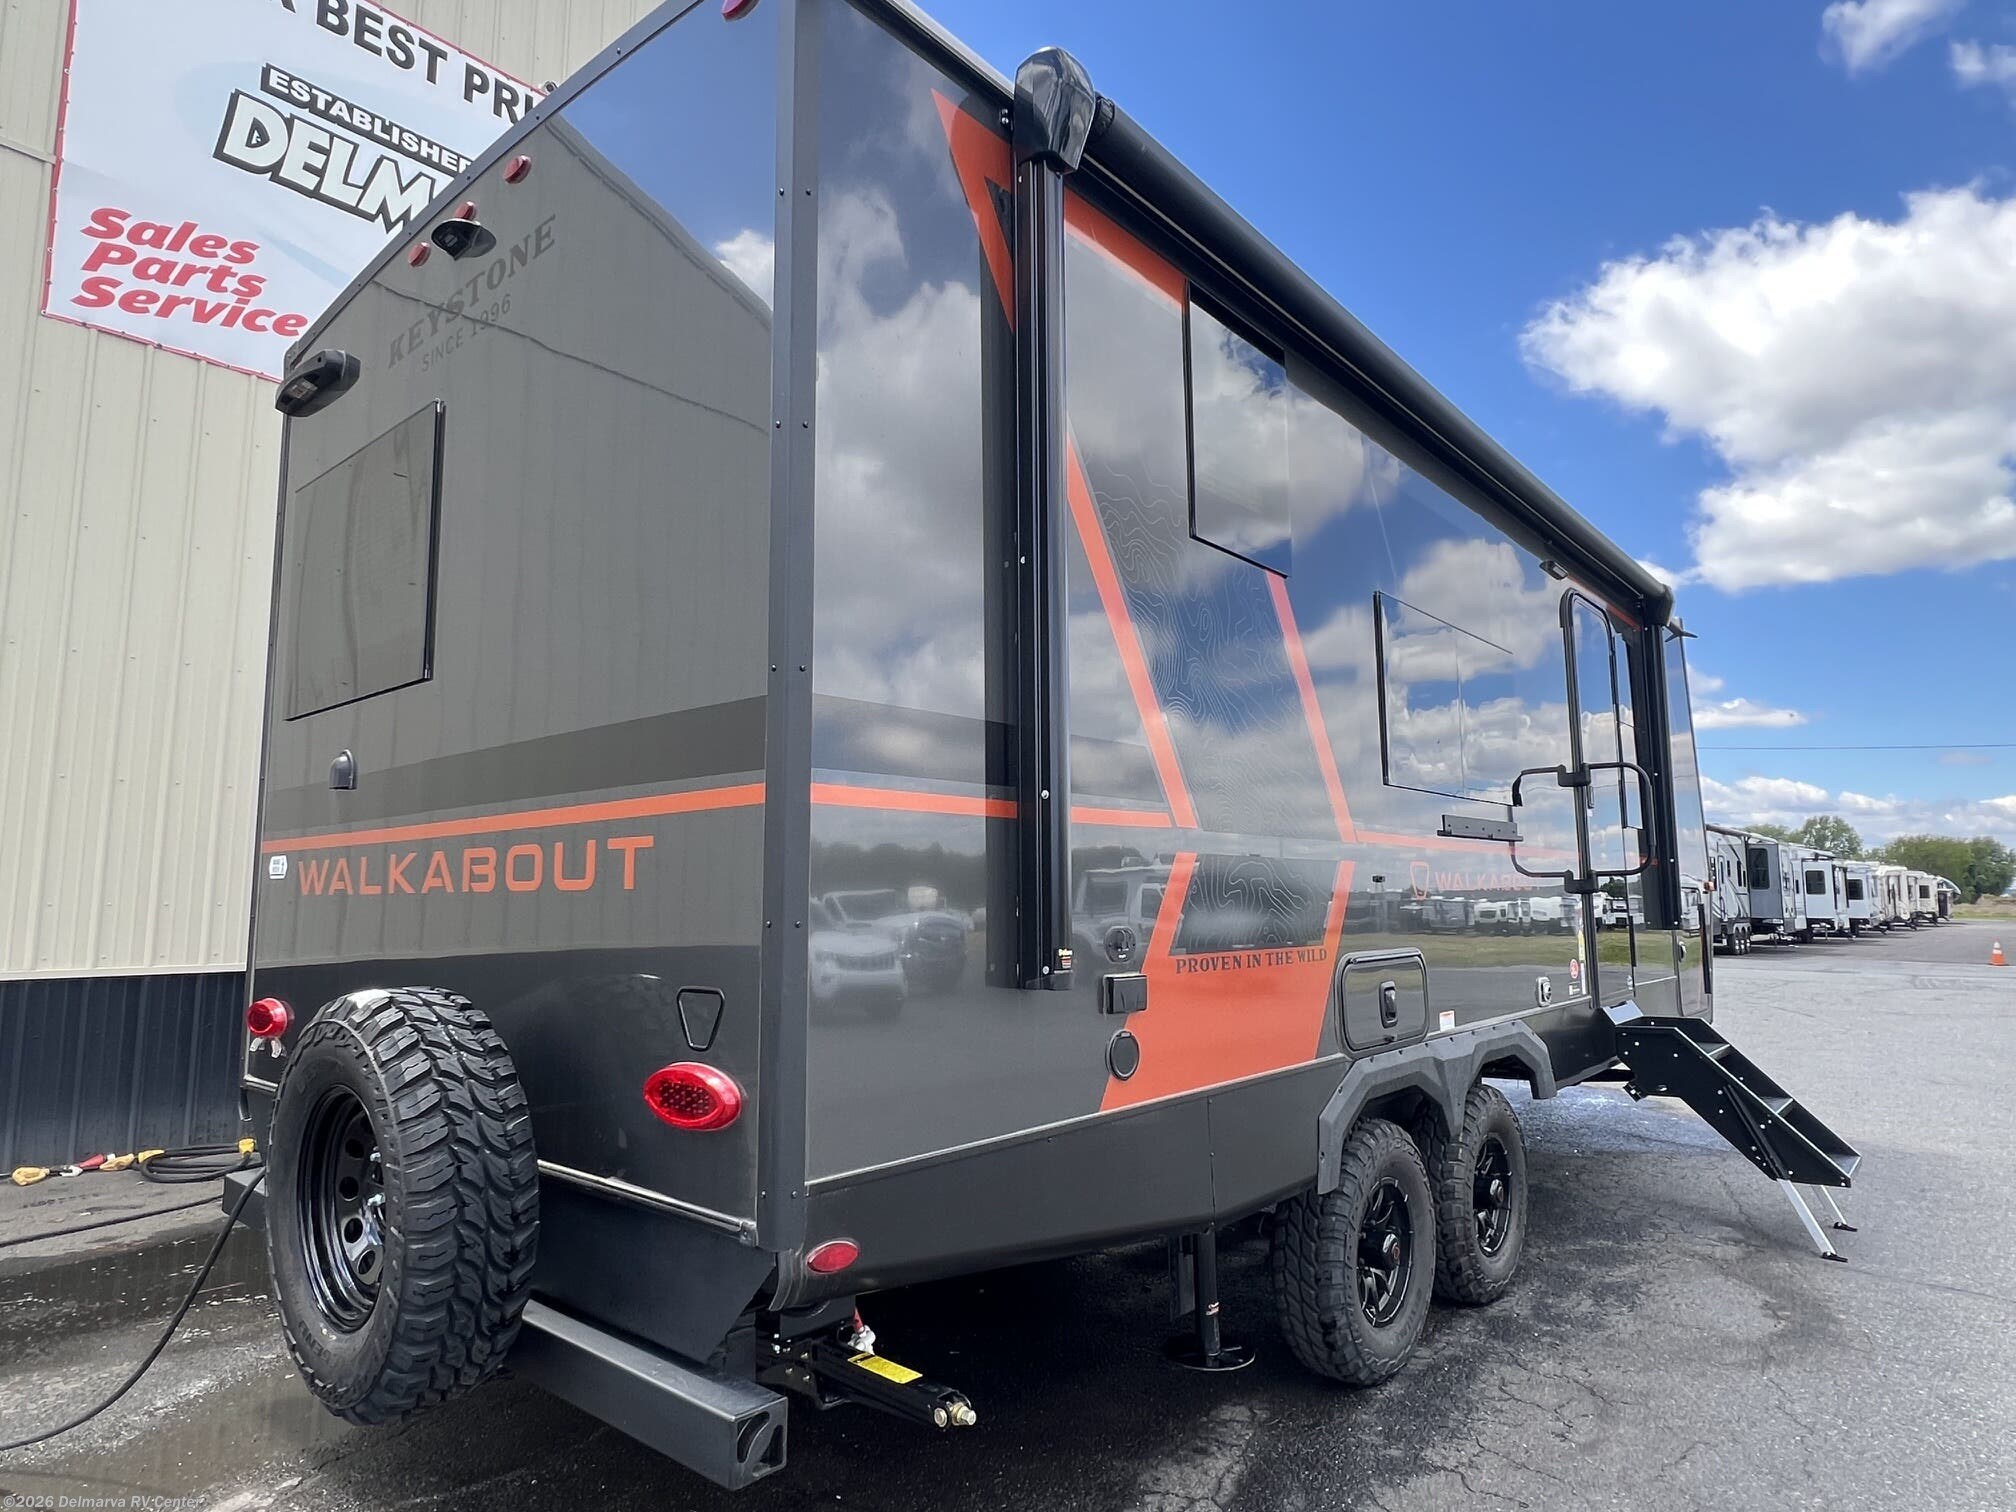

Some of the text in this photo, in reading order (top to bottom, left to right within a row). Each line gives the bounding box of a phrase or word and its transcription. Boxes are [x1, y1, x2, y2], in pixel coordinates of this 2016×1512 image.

[316, 0, 448, 84] BEST
[80, 207, 260, 264] Sales
[81, 241, 267, 298] Parts
[388, 214, 556, 369] KEYSTONE
[70, 276, 308, 337] Service
[421, 294, 511, 372] SINCE 1996
[298, 835, 655, 896] WALKABOUT
[1175, 948, 1328, 974] PROVEN IN THE WILD
